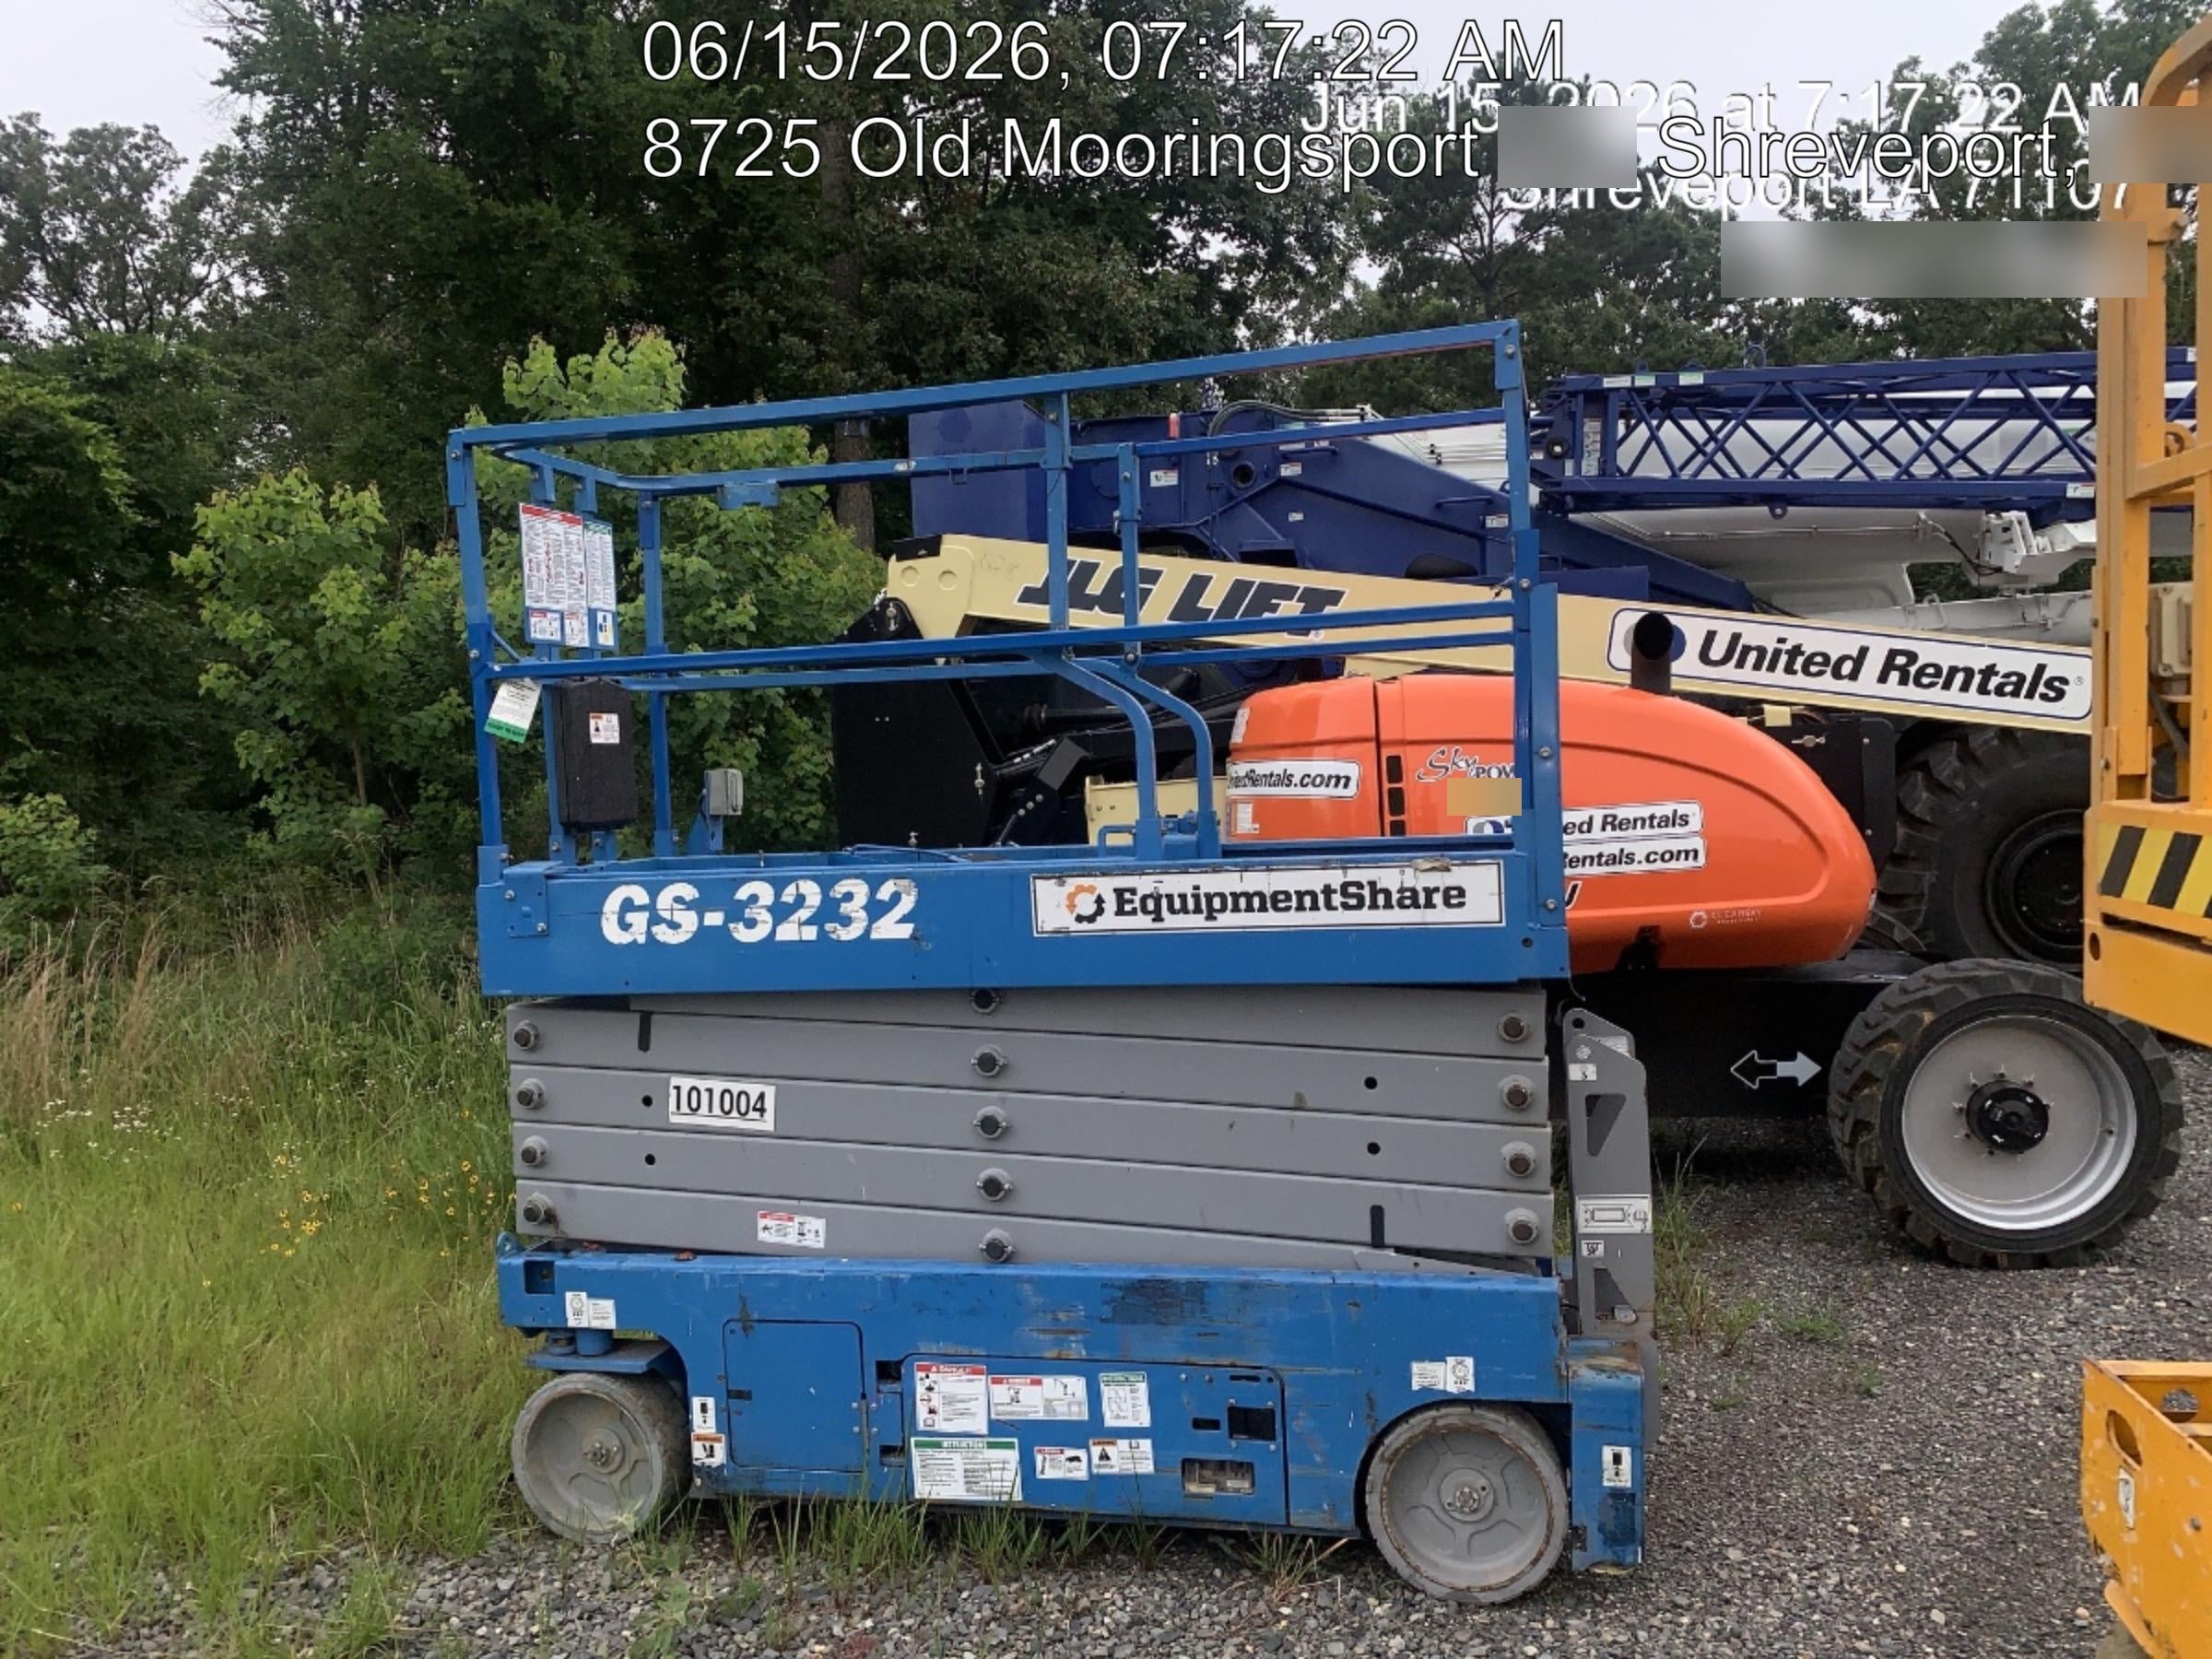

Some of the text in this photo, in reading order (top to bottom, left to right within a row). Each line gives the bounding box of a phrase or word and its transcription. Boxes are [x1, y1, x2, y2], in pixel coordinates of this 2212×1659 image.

[1698, 629, 2071, 703] United Rentals
[1600, 808, 1690, 833] Rentals
[600, 877, 919, 946] GS-3232
[1112, 879, 1467, 924] EquipmentShare
[672, 1084, 768, 1119] 101004
